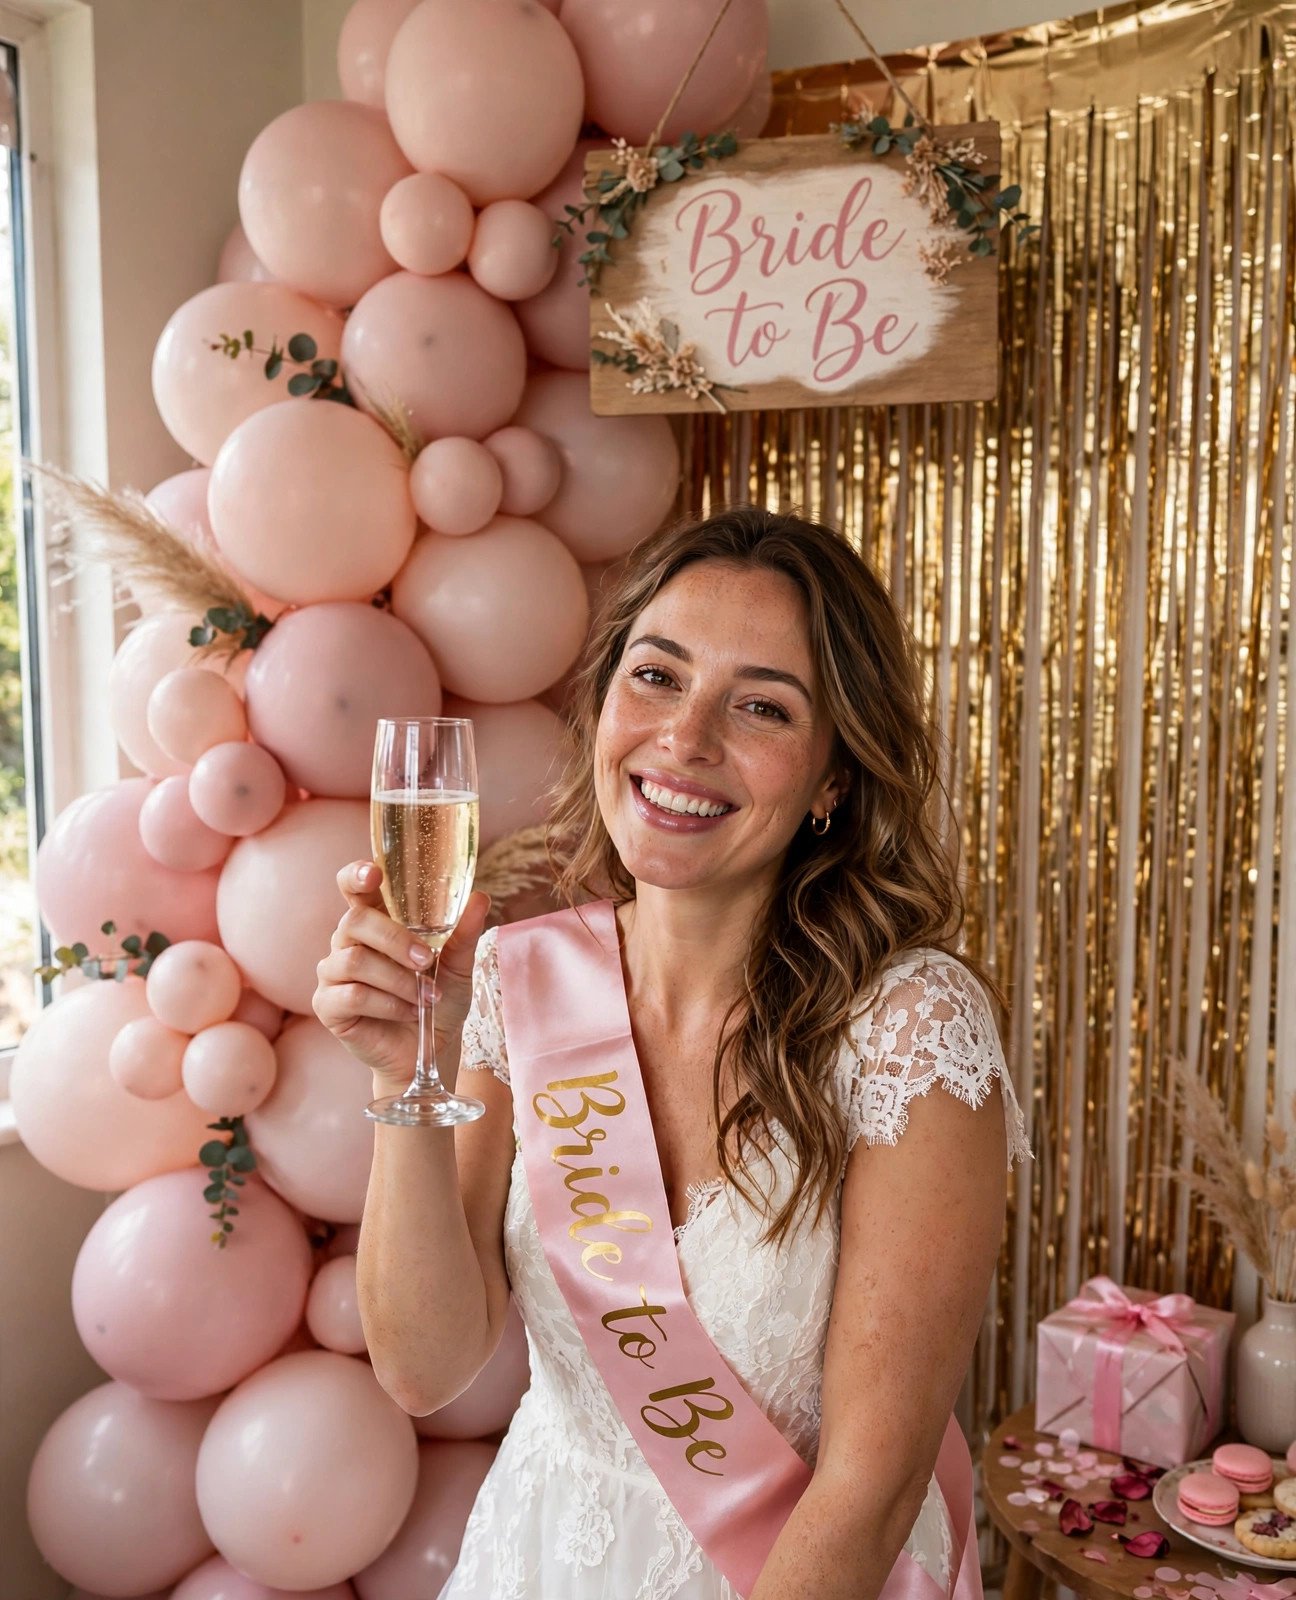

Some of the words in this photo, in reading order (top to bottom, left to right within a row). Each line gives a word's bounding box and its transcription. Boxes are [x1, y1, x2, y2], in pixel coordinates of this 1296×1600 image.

[675, 176, 906, 296] Bride
[704, 291, 790, 368] to
[805, 278, 918, 383] Be
[532, 1070, 653, 1282] Bride
[601, 1284, 668, 1370] to
[640, 1377, 735, 1477] Be
